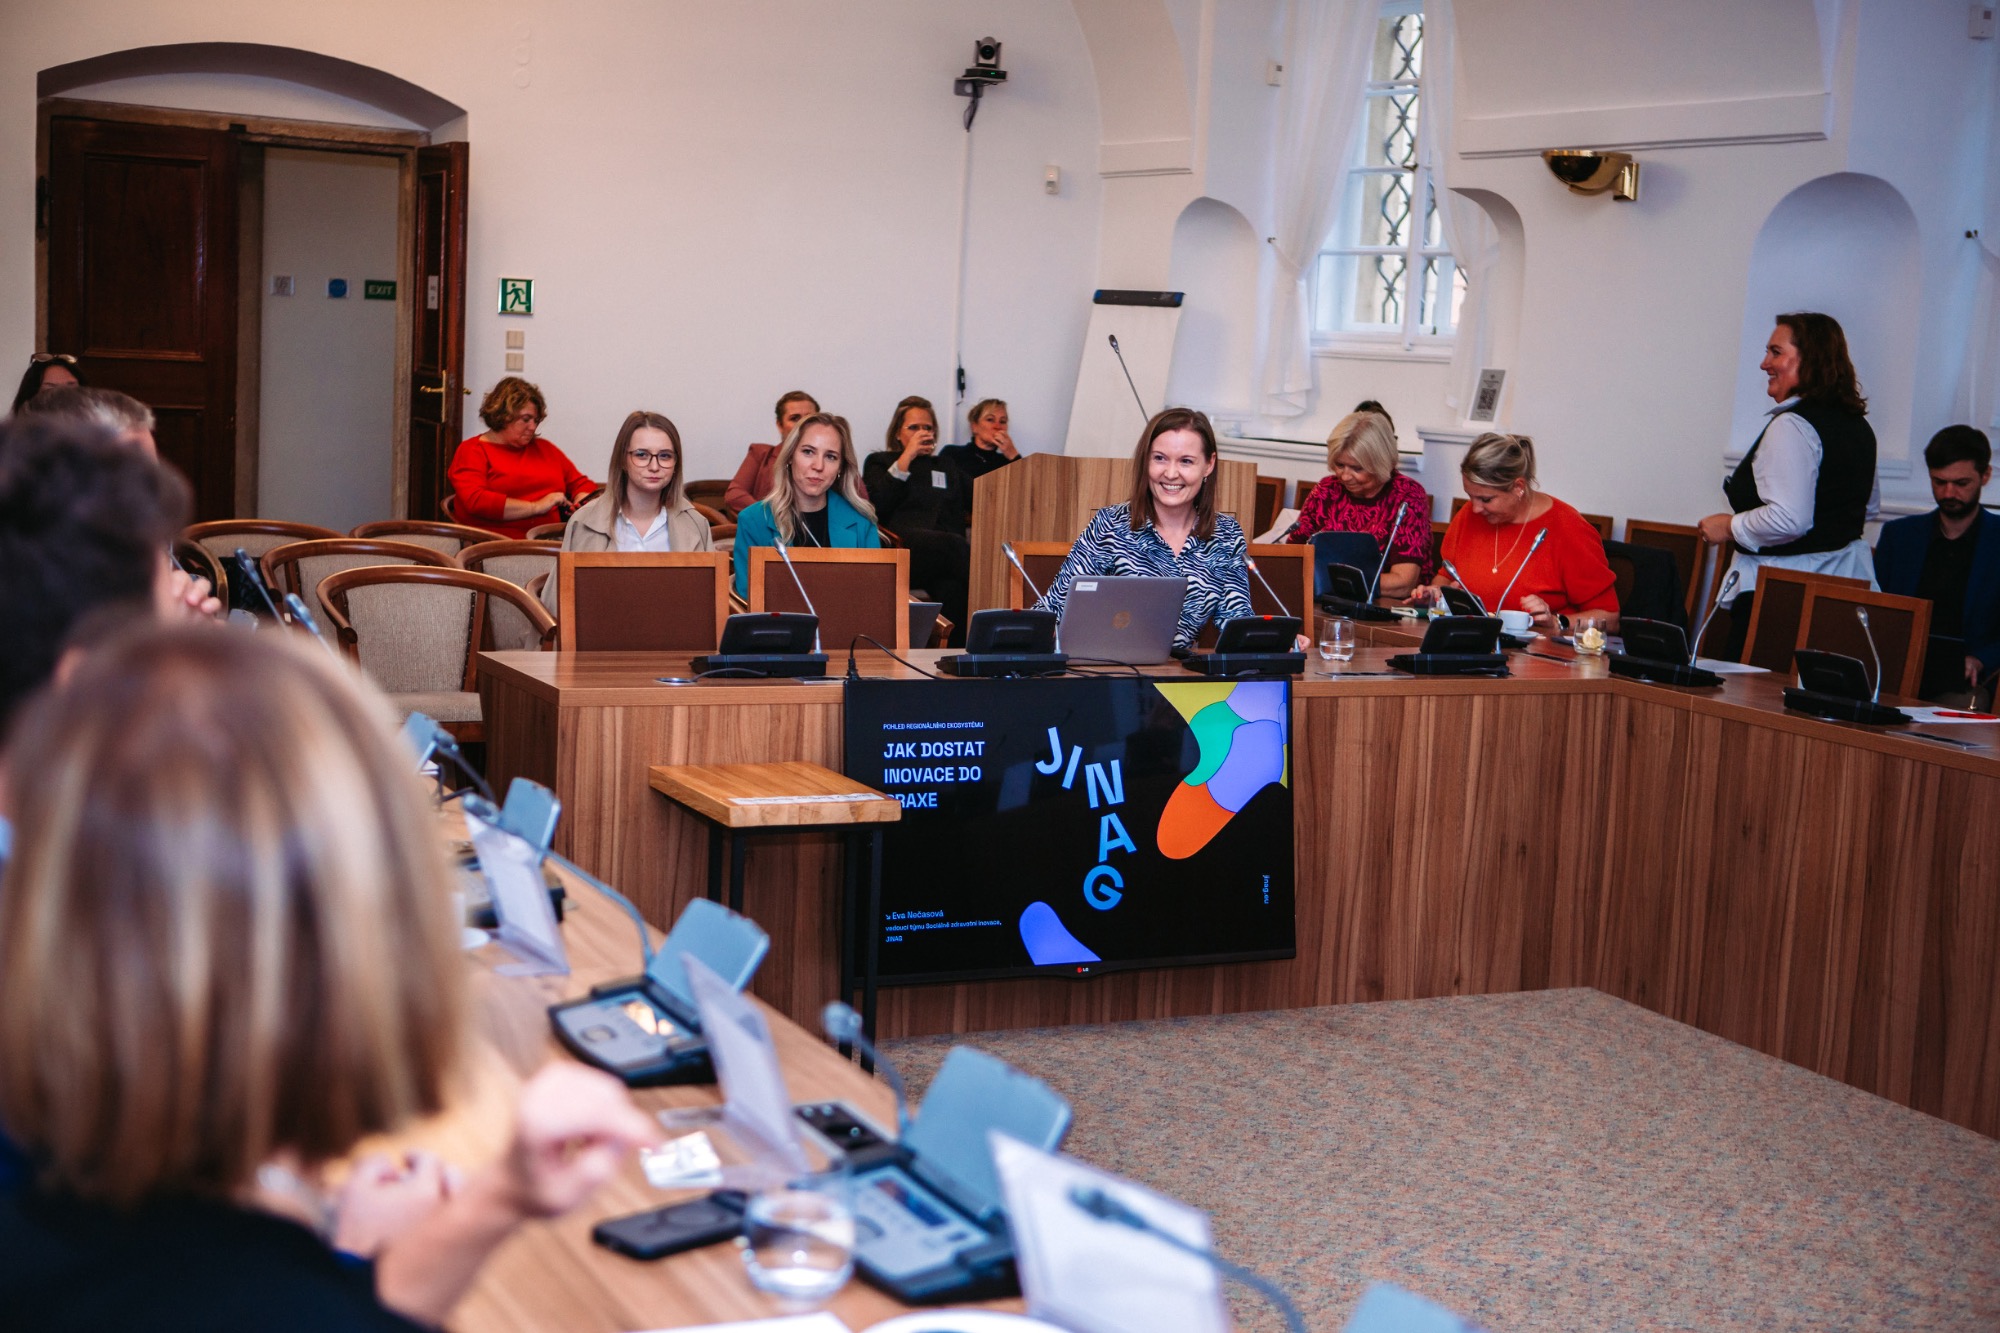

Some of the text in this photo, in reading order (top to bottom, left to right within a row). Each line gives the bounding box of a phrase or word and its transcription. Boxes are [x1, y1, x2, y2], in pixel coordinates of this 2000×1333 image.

[368, 284, 393, 296] EXIT
[906, 722, 946, 730] REGIONÁLNÍHO
[946, 721, 984, 729] EKOSYSTÉMU
[883, 741, 985, 758] JAK DOSTAT
[884, 766, 981, 783] INOVACE DO
[888, 792, 938, 808] RAXE
[892, 910, 944, 920] Eva Nečasová
